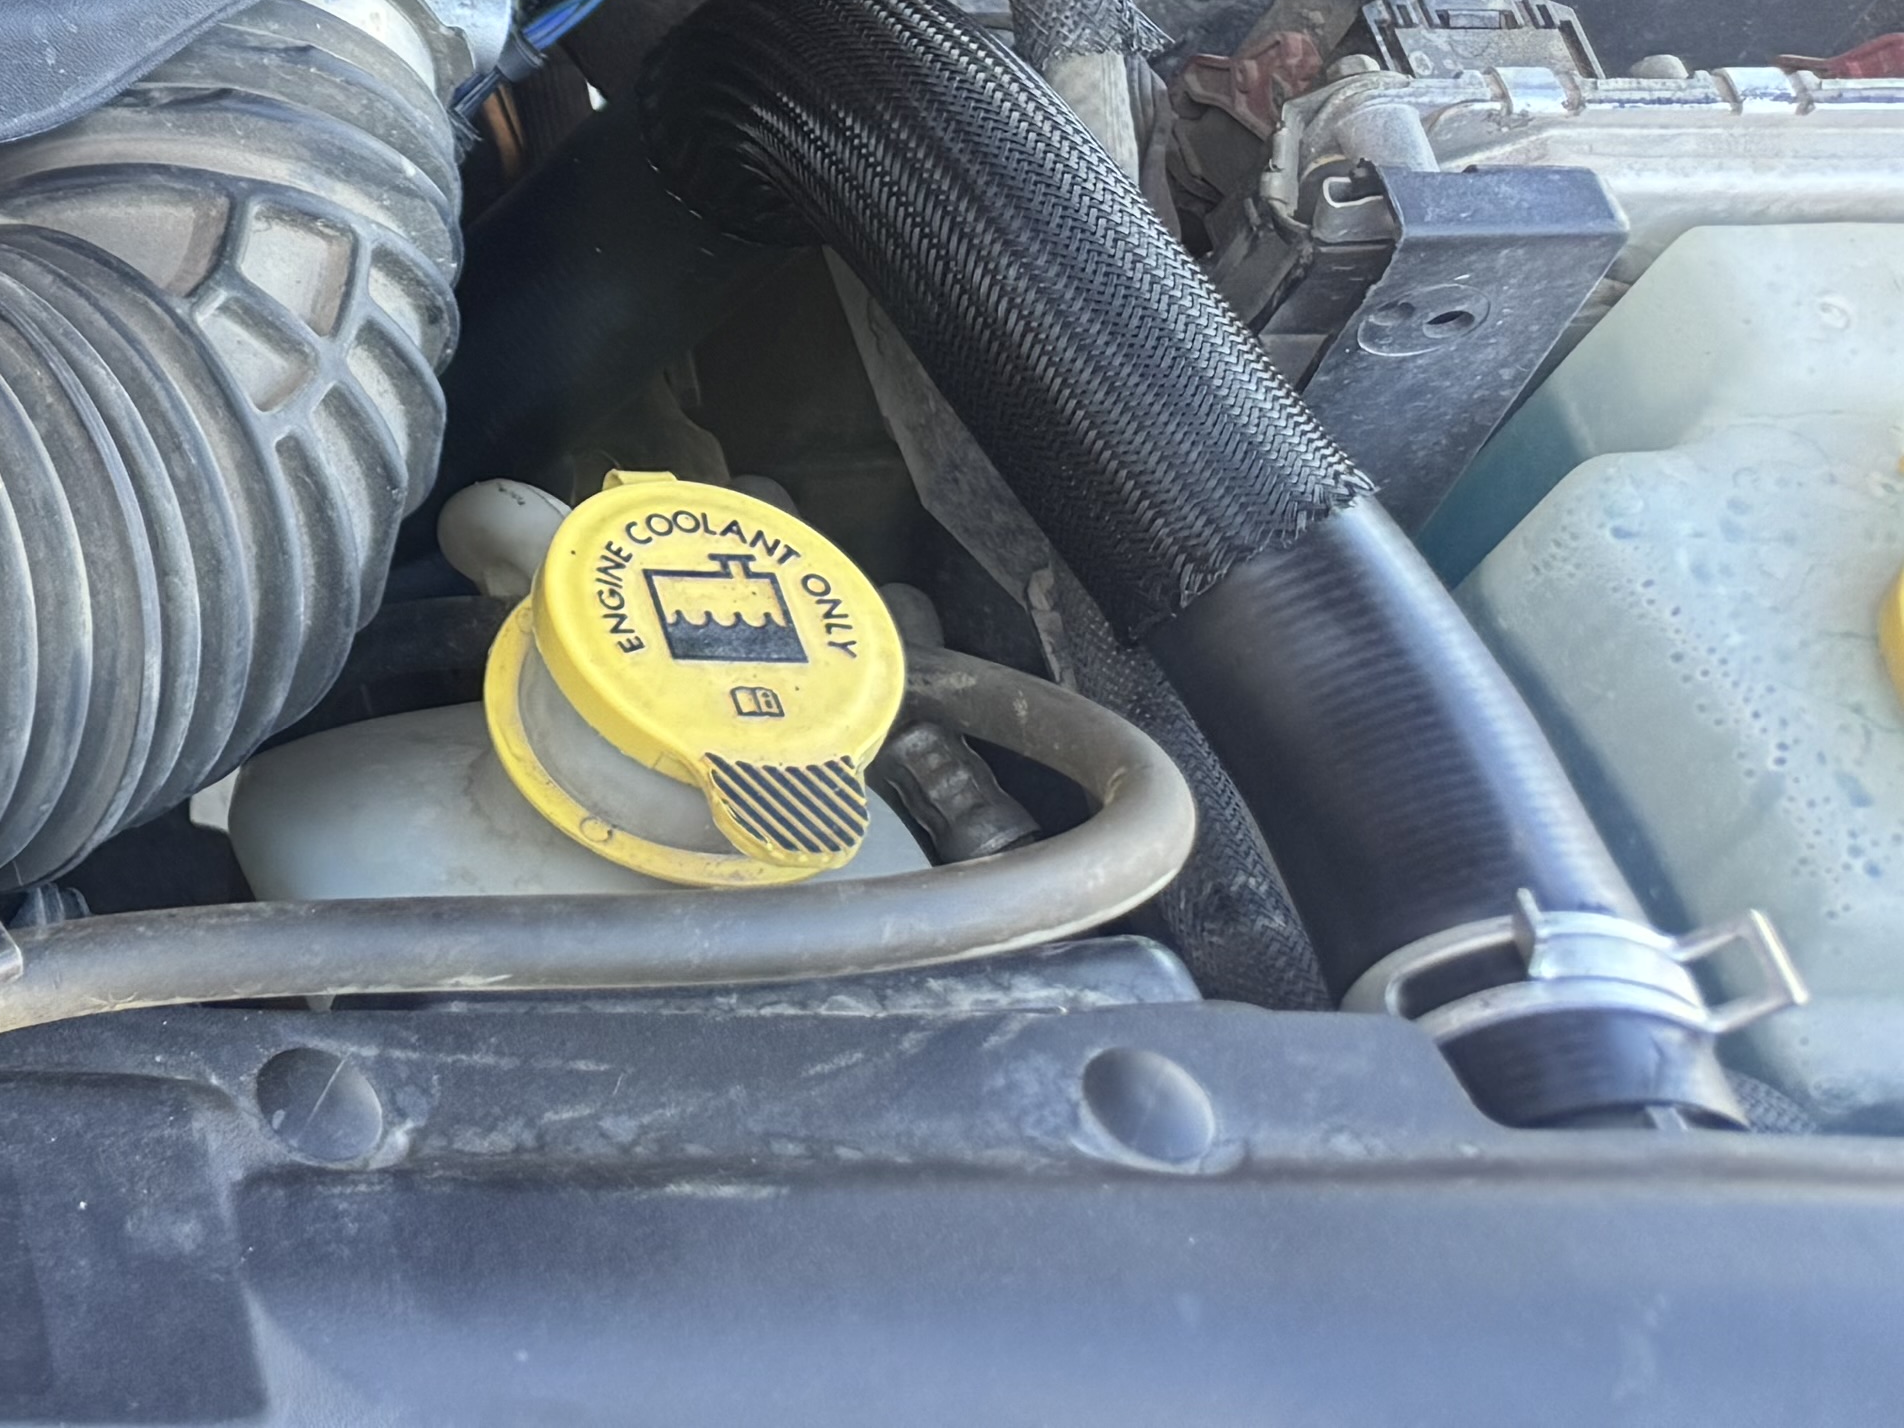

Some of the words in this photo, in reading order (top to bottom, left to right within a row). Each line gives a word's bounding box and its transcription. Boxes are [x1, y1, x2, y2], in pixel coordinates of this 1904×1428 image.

[595, 540, 645, 654] ENGINE
[624, 509, 802, 566] COOLANT
[801, 573, 858, 659] ONLY
